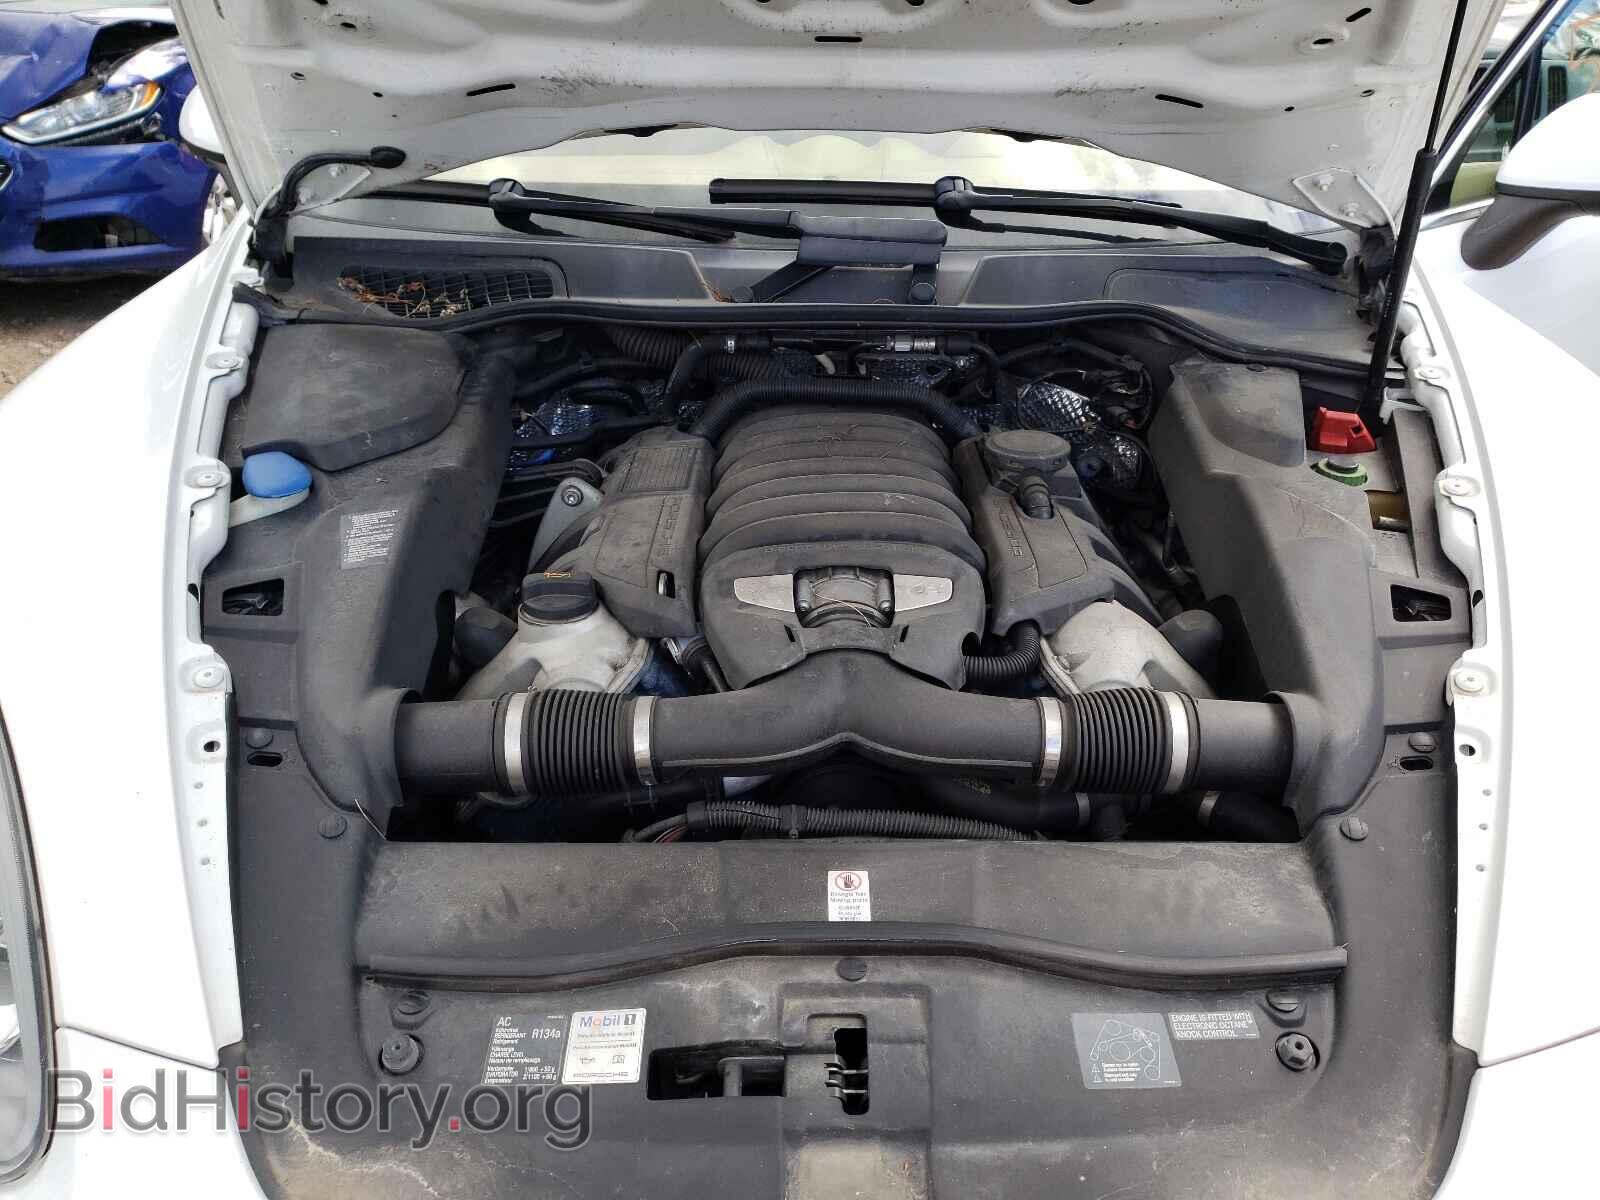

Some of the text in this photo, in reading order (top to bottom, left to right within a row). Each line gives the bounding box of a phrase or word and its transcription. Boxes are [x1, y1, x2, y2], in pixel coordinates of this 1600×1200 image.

[496, 1016, 512, 1027] AC
[579, 1014, 621, 1027] Mobil
[1171, 1014, 1199, 1022] ENGINE
[1208, 1013, 1232, 1021] FITTED
[1174, 1021, 1248, 1030] ELECTRONIC OCTANE
[532, 1028, 561, 1039] R134a
[1176, 1029, 1202, 1038] KNOCK
[1202, 1029, 1238, 1038] CONTROL
